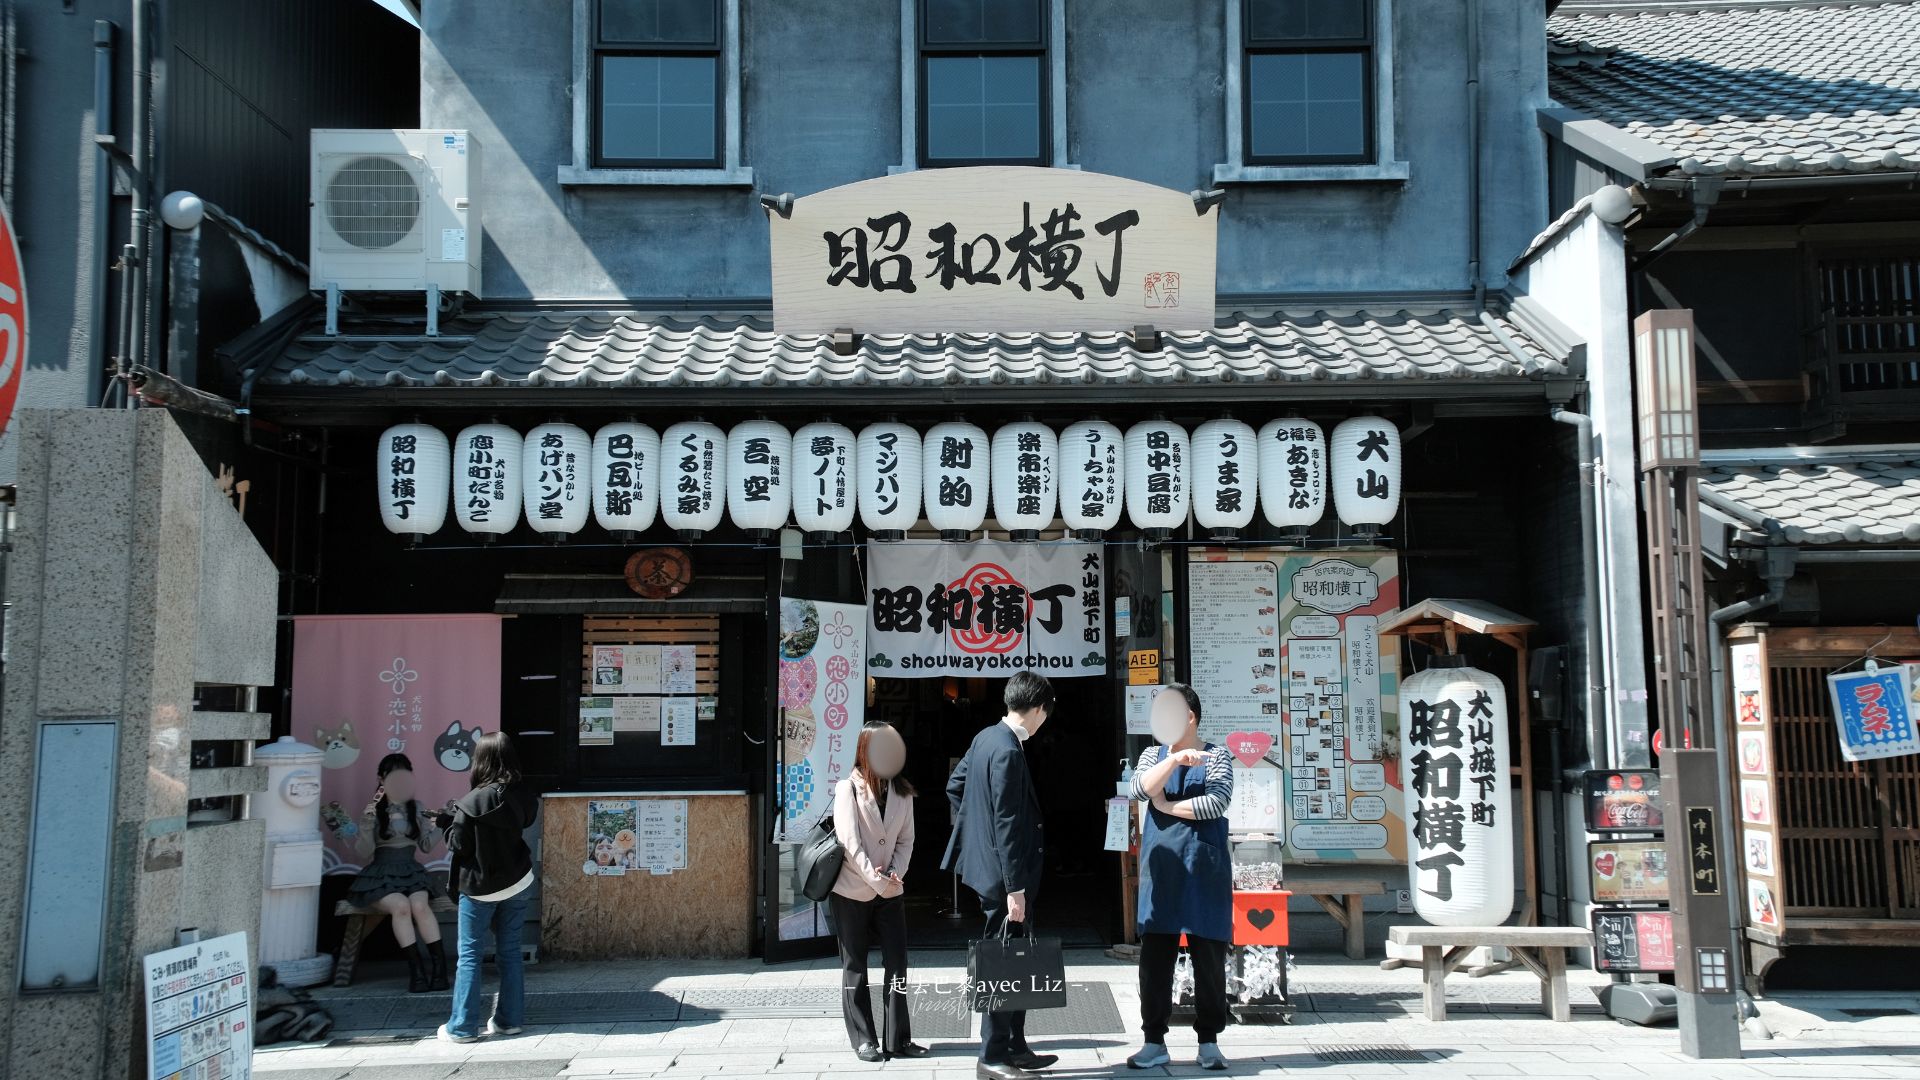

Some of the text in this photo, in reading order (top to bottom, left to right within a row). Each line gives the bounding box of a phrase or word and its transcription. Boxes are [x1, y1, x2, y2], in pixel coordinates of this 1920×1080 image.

[823, 201, 1140, 300] 昭和横丁
[390, 434, 417, 520] 昭和横丁
[468, 434, 494, 522] 恋小町だんご
[494, 458, 506, 501] 犬山名物
[538, 432, 564, 519] あげパン堂
[565, 452, 576, 501] 昔なつかし
[605, 433, 634, 516] 巴瓦斯
[633, 450, 645, 501] 地ビール処
[677, 433, 702, 515] くるみ家
[702, 439, 713, 511] 自然薯たこ焼き
[743, 437, 771, 502] 吾空
[811, 435, 835, 516] 夢ノート
[836, 445, 846, 508] 下町人情屋台
[875, 432, 899, 516] マジパン
[939, 436, 974, 508] 射的
[1016, 431, 1042, 515] 楽市楽座
[1043, 456, 1051, 493] イベント
[1081, 429, 1105, 518] うーちゃん家
[1106, 444, 1116, 505] 犬山からあげ
[1146, 430, 1171, 514] 田中豆腐
[1215, 432, 1242, 513] うま家
[1286, 444, 1310, 510] あきな
[1356, 430, 1390, 500] 犬山
[872, 582, 1076, 634] 昭和横丁
[1081, 552, 1100, 644] 犬山城下町
[1302, 580, 1367, 597] 昭和横丁
[850, 639, 860, 680] 犬山名物
[900, 653, 1074, 672] shouwayokochou
[1130, 653, 1157, 666] AED
[1352, 640, 1362, 684] 昭和横丁へ
[1364, 624, 1375, 676] ようこそ犬山
[387, 697, 407, 754] 恋小町
[411, 696, 424, 733] 犬山名物
[1854, 682, 1894, 736] ラムネ
[1467, 689, 1497, 828] 犬山城下町
[1409, 698, 1467, 902] 昭和横丁
[1607, 803, 1649, 819] Coca-Cola
[1692, 818, 1715, 884] 中本町
